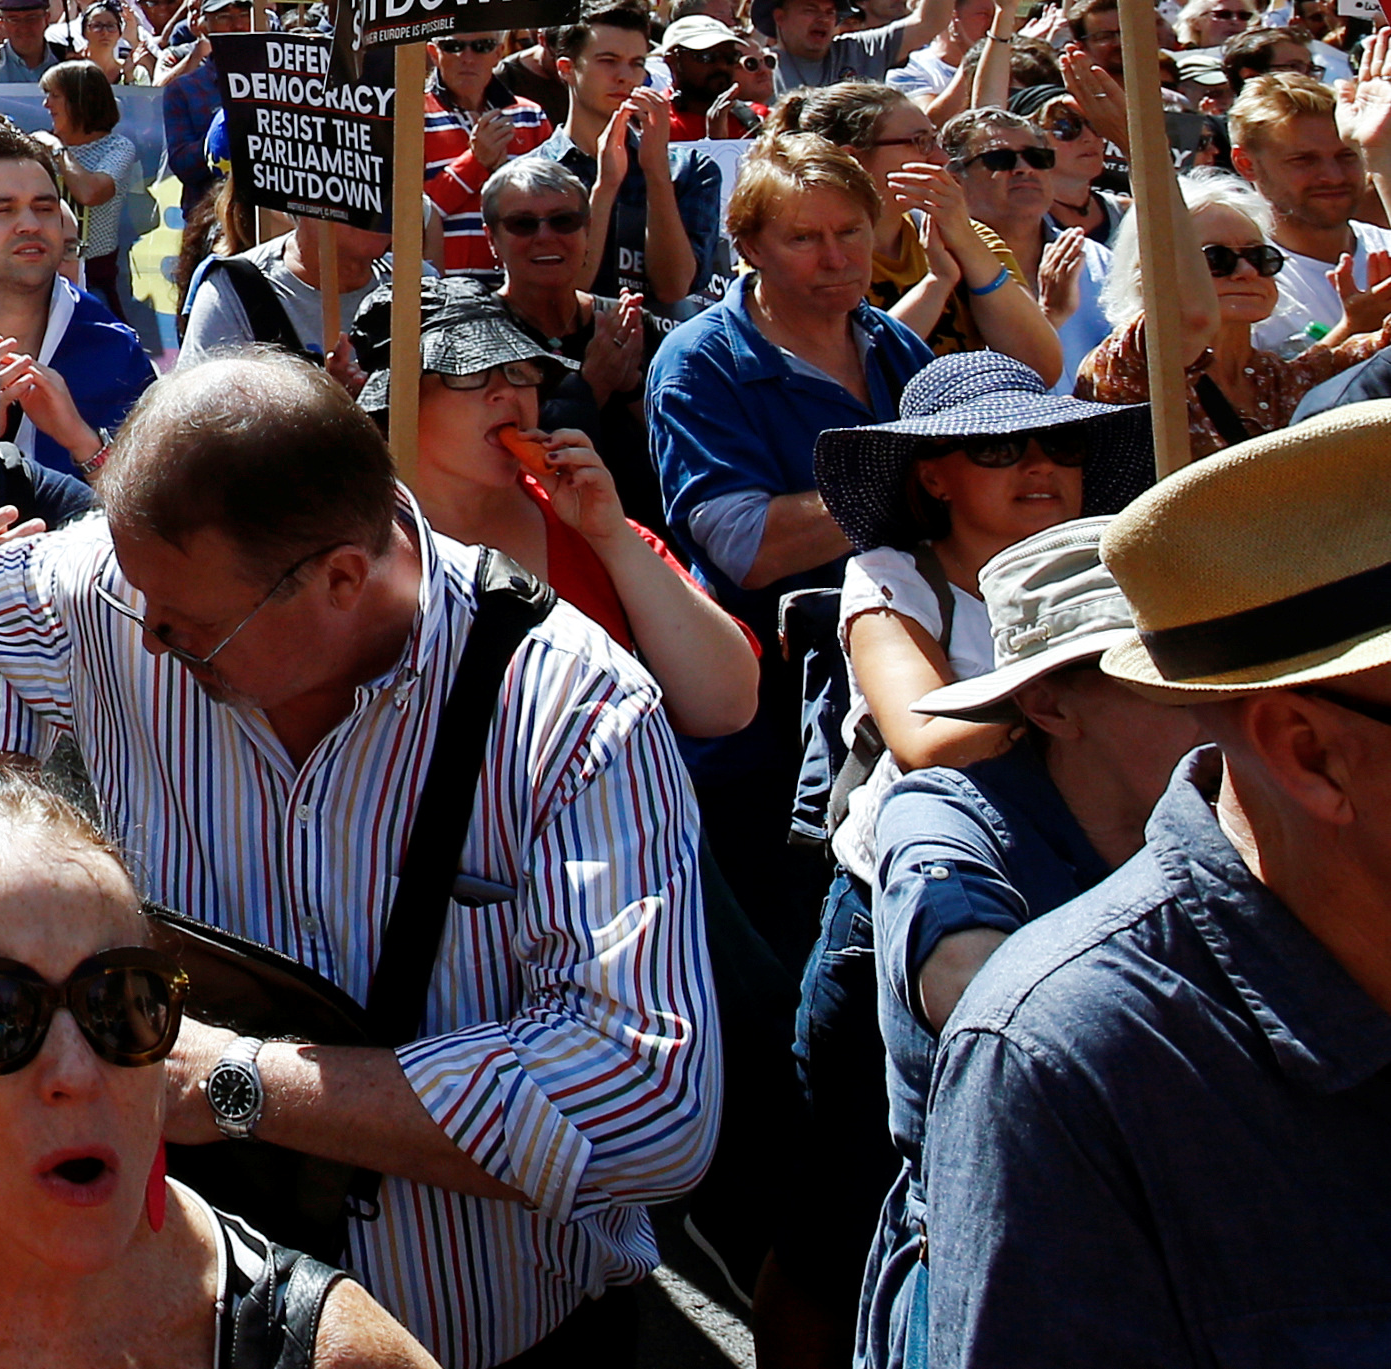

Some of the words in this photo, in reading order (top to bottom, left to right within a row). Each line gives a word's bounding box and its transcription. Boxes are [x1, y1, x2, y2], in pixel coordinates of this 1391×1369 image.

[378, 24, 409, 42] EUROPE
[411, 23, 420, 37] IS
[420, 17, 455, 35] POSSIBLE
[227, 73, 396, 117] DEMOCRACY
[256, 108, 326, 143] RESIST
[331, 118, 372, 152] THE
[247, 134, 383, 183] PARLIAMENT
[253, 163, 382, 214] SHUTDOWN
